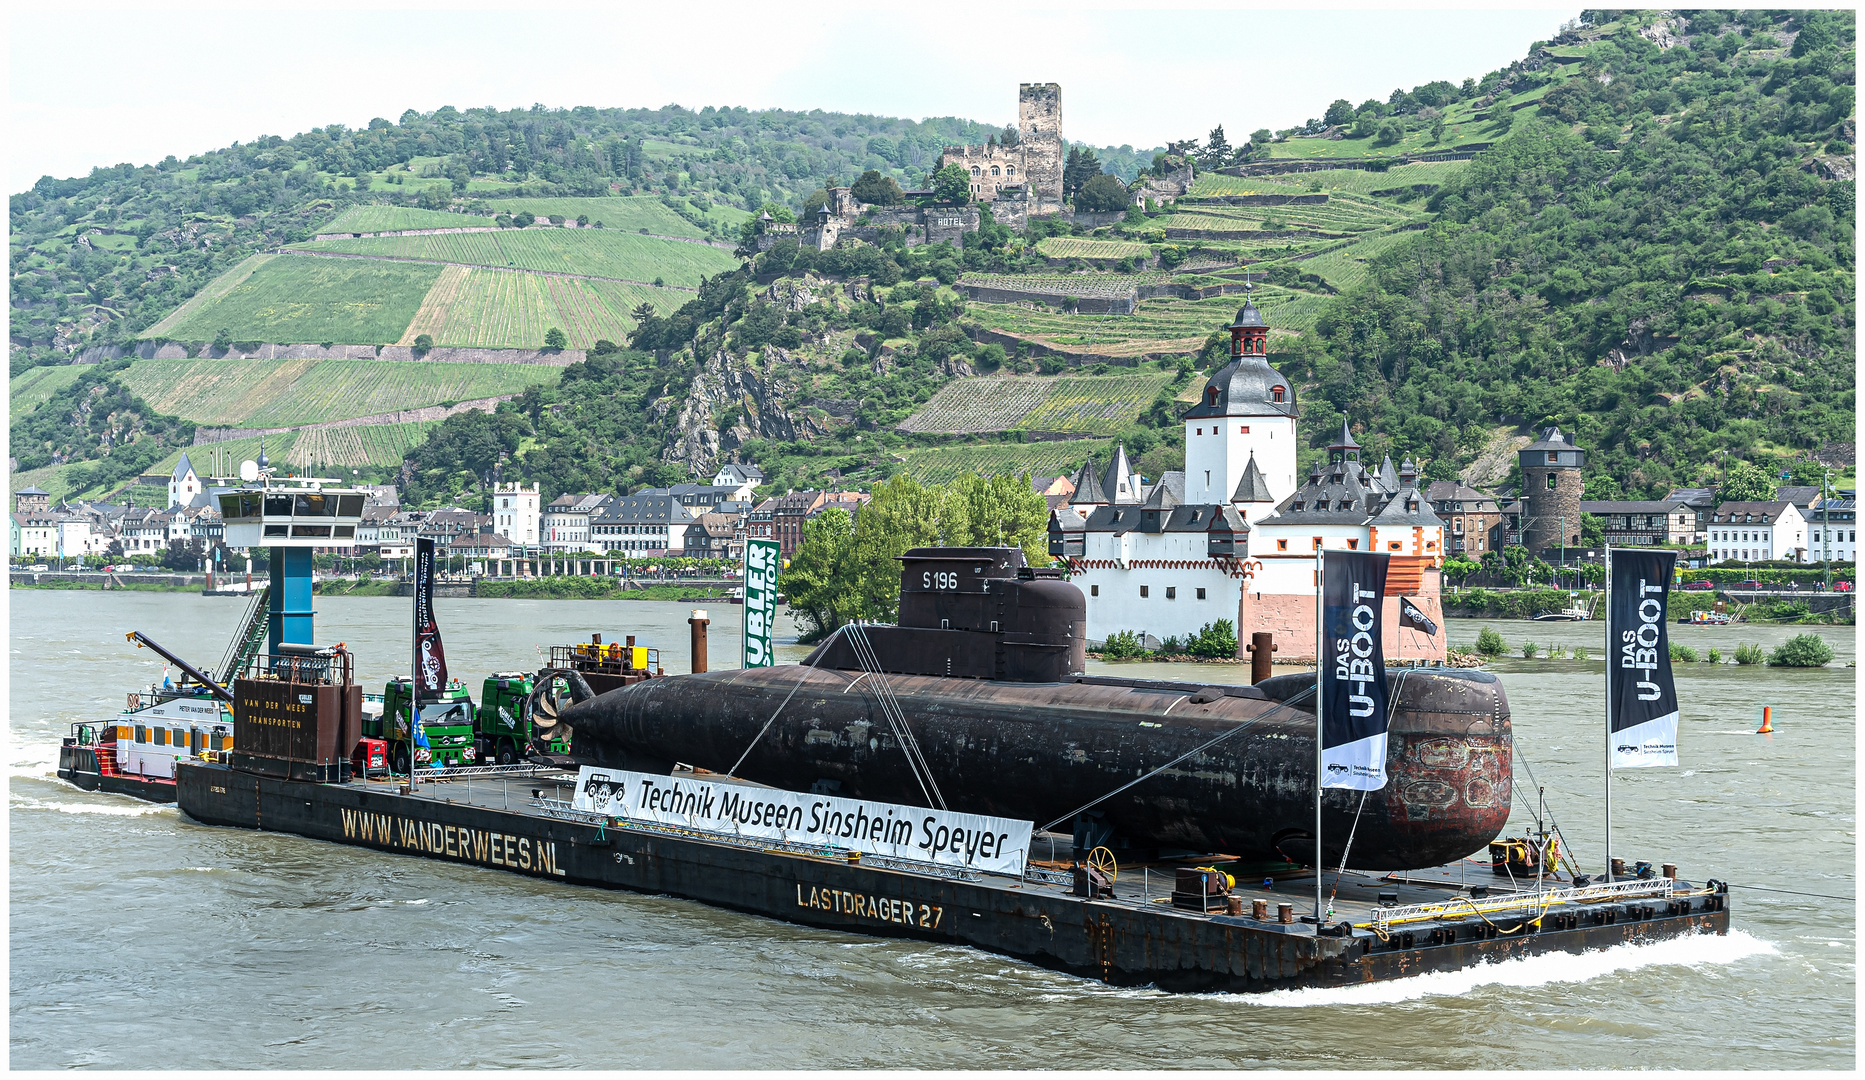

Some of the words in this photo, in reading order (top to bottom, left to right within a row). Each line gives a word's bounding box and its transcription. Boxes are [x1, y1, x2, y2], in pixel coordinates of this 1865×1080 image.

[938, 217, 965, 226] HOTEL
[923, 571, 931, 589] S
[933, 571, 958, 590] 196
[421, 586, 430, 628] Sinsheim
[1336, 637, 1350, 681] DAS
[1349, 582, 1376, 718] U-BOOT
[1621, 630, 1636, 669] DAS
[1635, 578, 1663, 701] U-BOOT
[244, 698, 259, 708] VAN
[265, 701, 279, 710] DER
[286, 703, 306, 712] WEES
[248, 715, 301, 728] TRANSPORTEN
[341, 807, 567, 876] WWW.VANDERWEES.NL
[641, 779, 716, 820] Technik
[717, 792, 803, 831] Museen
[806, 801, 912, 846] Sinsheim
[918, 816, 1009, 865] Speyer
[797, 883, 914, 925] LASTDRAGER
[918, 904, 944, 929] 27
